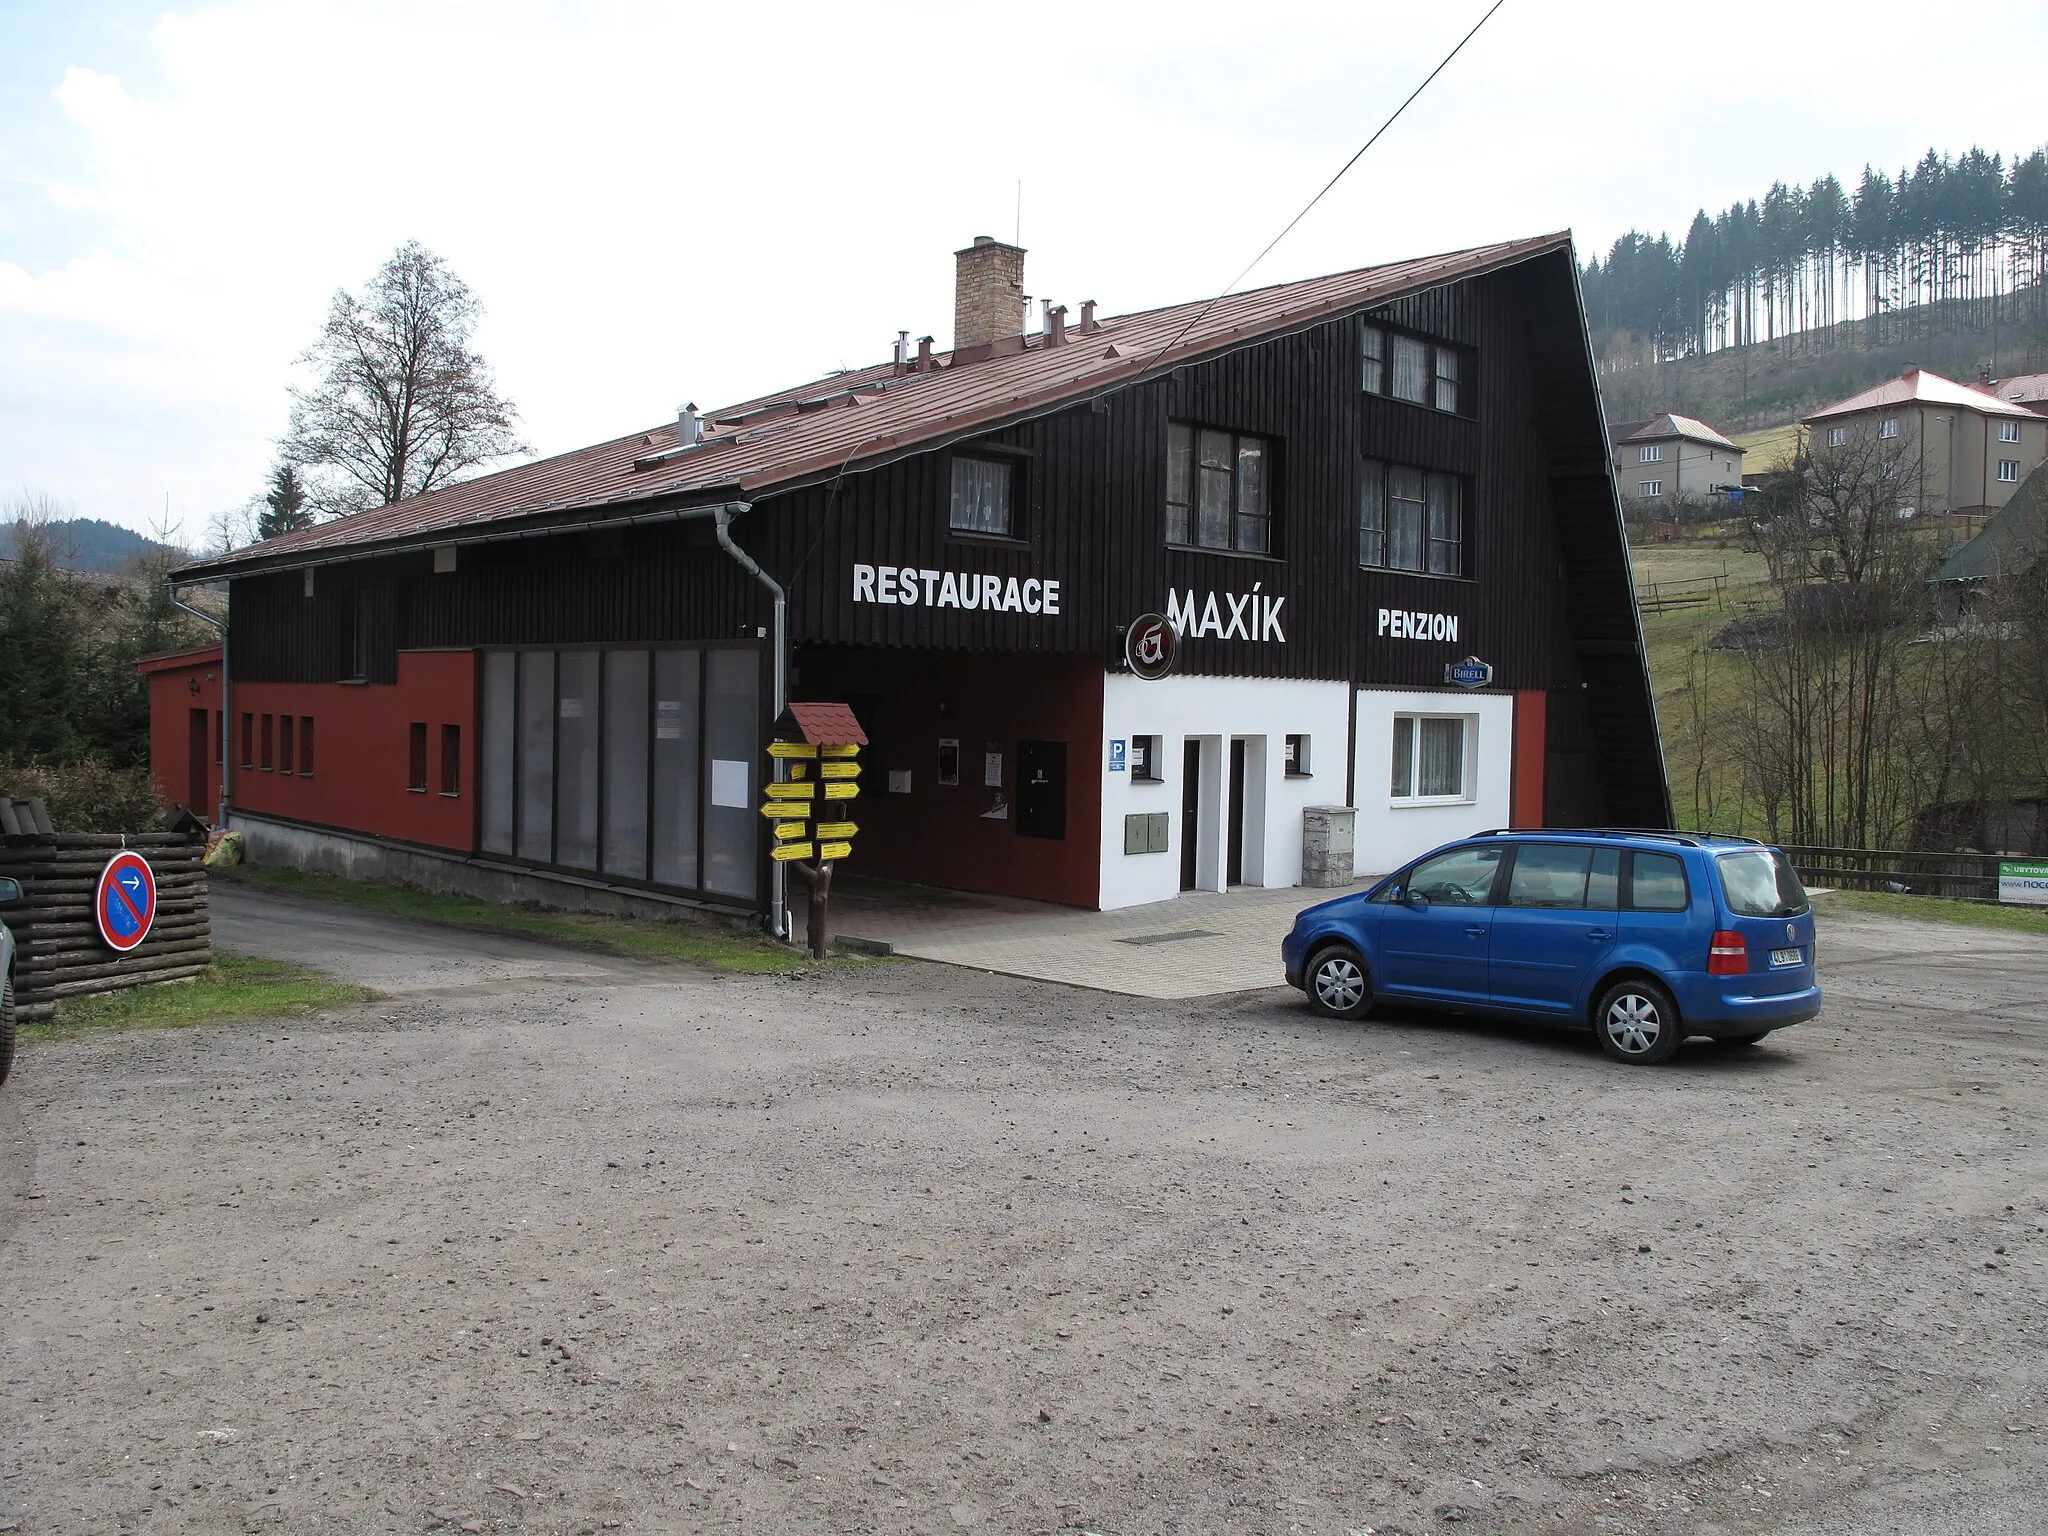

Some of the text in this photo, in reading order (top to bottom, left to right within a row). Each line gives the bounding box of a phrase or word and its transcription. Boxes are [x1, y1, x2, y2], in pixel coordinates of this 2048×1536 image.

[853, 563, 1060, 615] RESTAURACE
[1166, 582, 1286, 643] MAXÍK
[1378, 608, 1458, 643] PENZION
[1453, 668, 1486, 679] BIRELL
[1112, 742, 1123, 759] P
